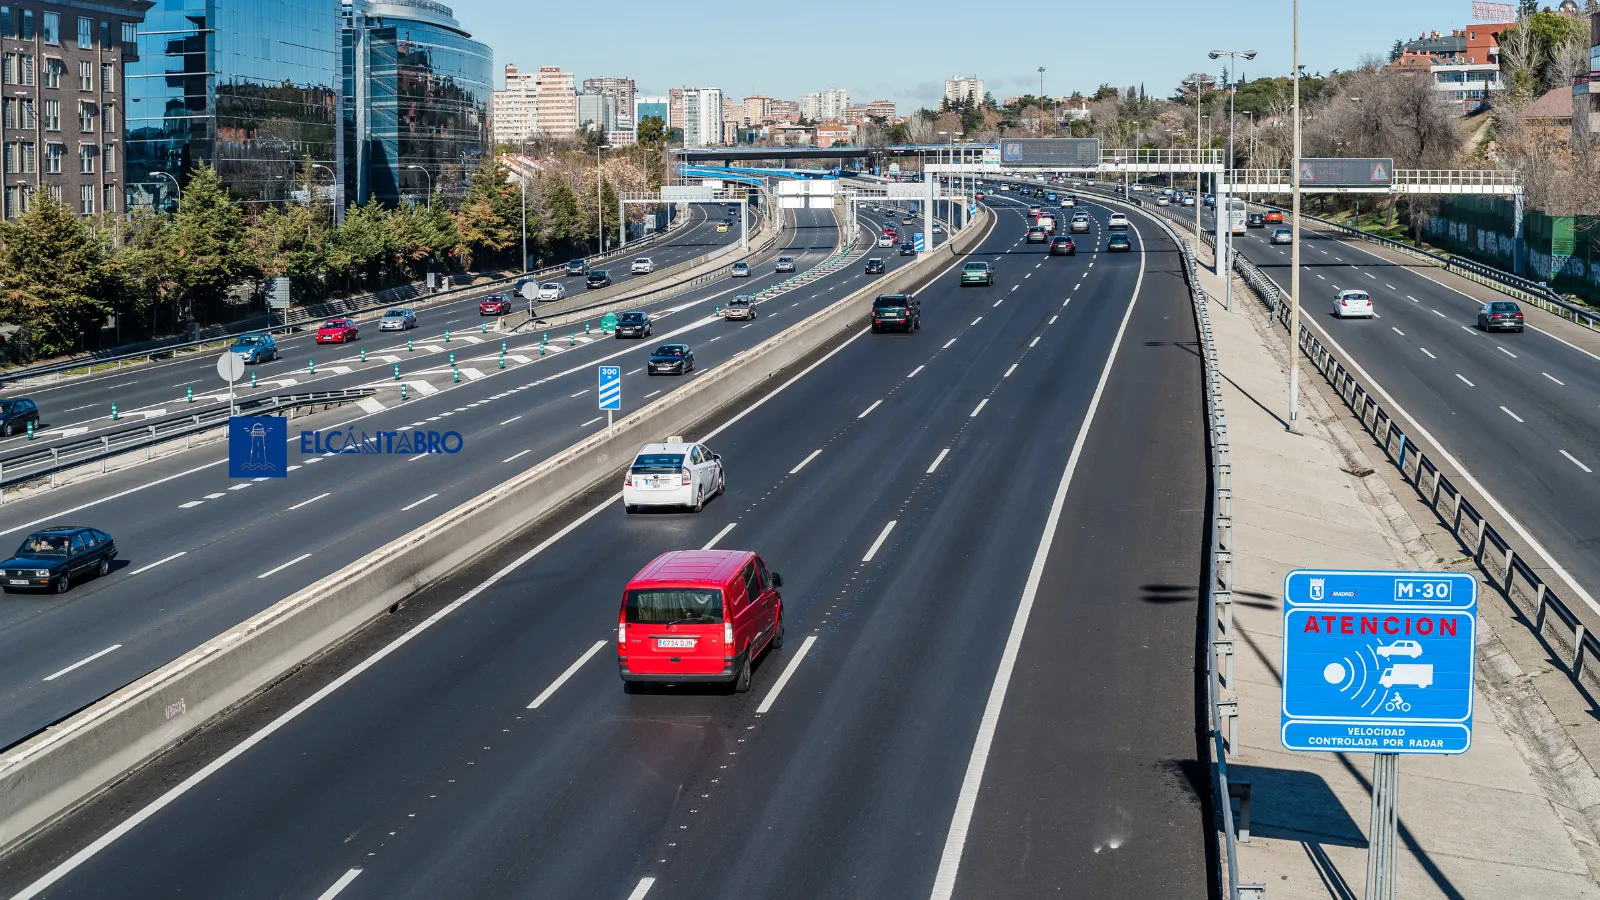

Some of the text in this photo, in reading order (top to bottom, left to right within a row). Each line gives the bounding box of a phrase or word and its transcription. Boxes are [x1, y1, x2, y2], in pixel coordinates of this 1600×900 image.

[1398, 582, 1449, 598] M-30
[1303, 615, 1457, 636] ATENCION
[1347, 727, 1406, 736] VELOCIDAD
[1308, 737, 1444, 748] CONTROLADA POR RADAR
